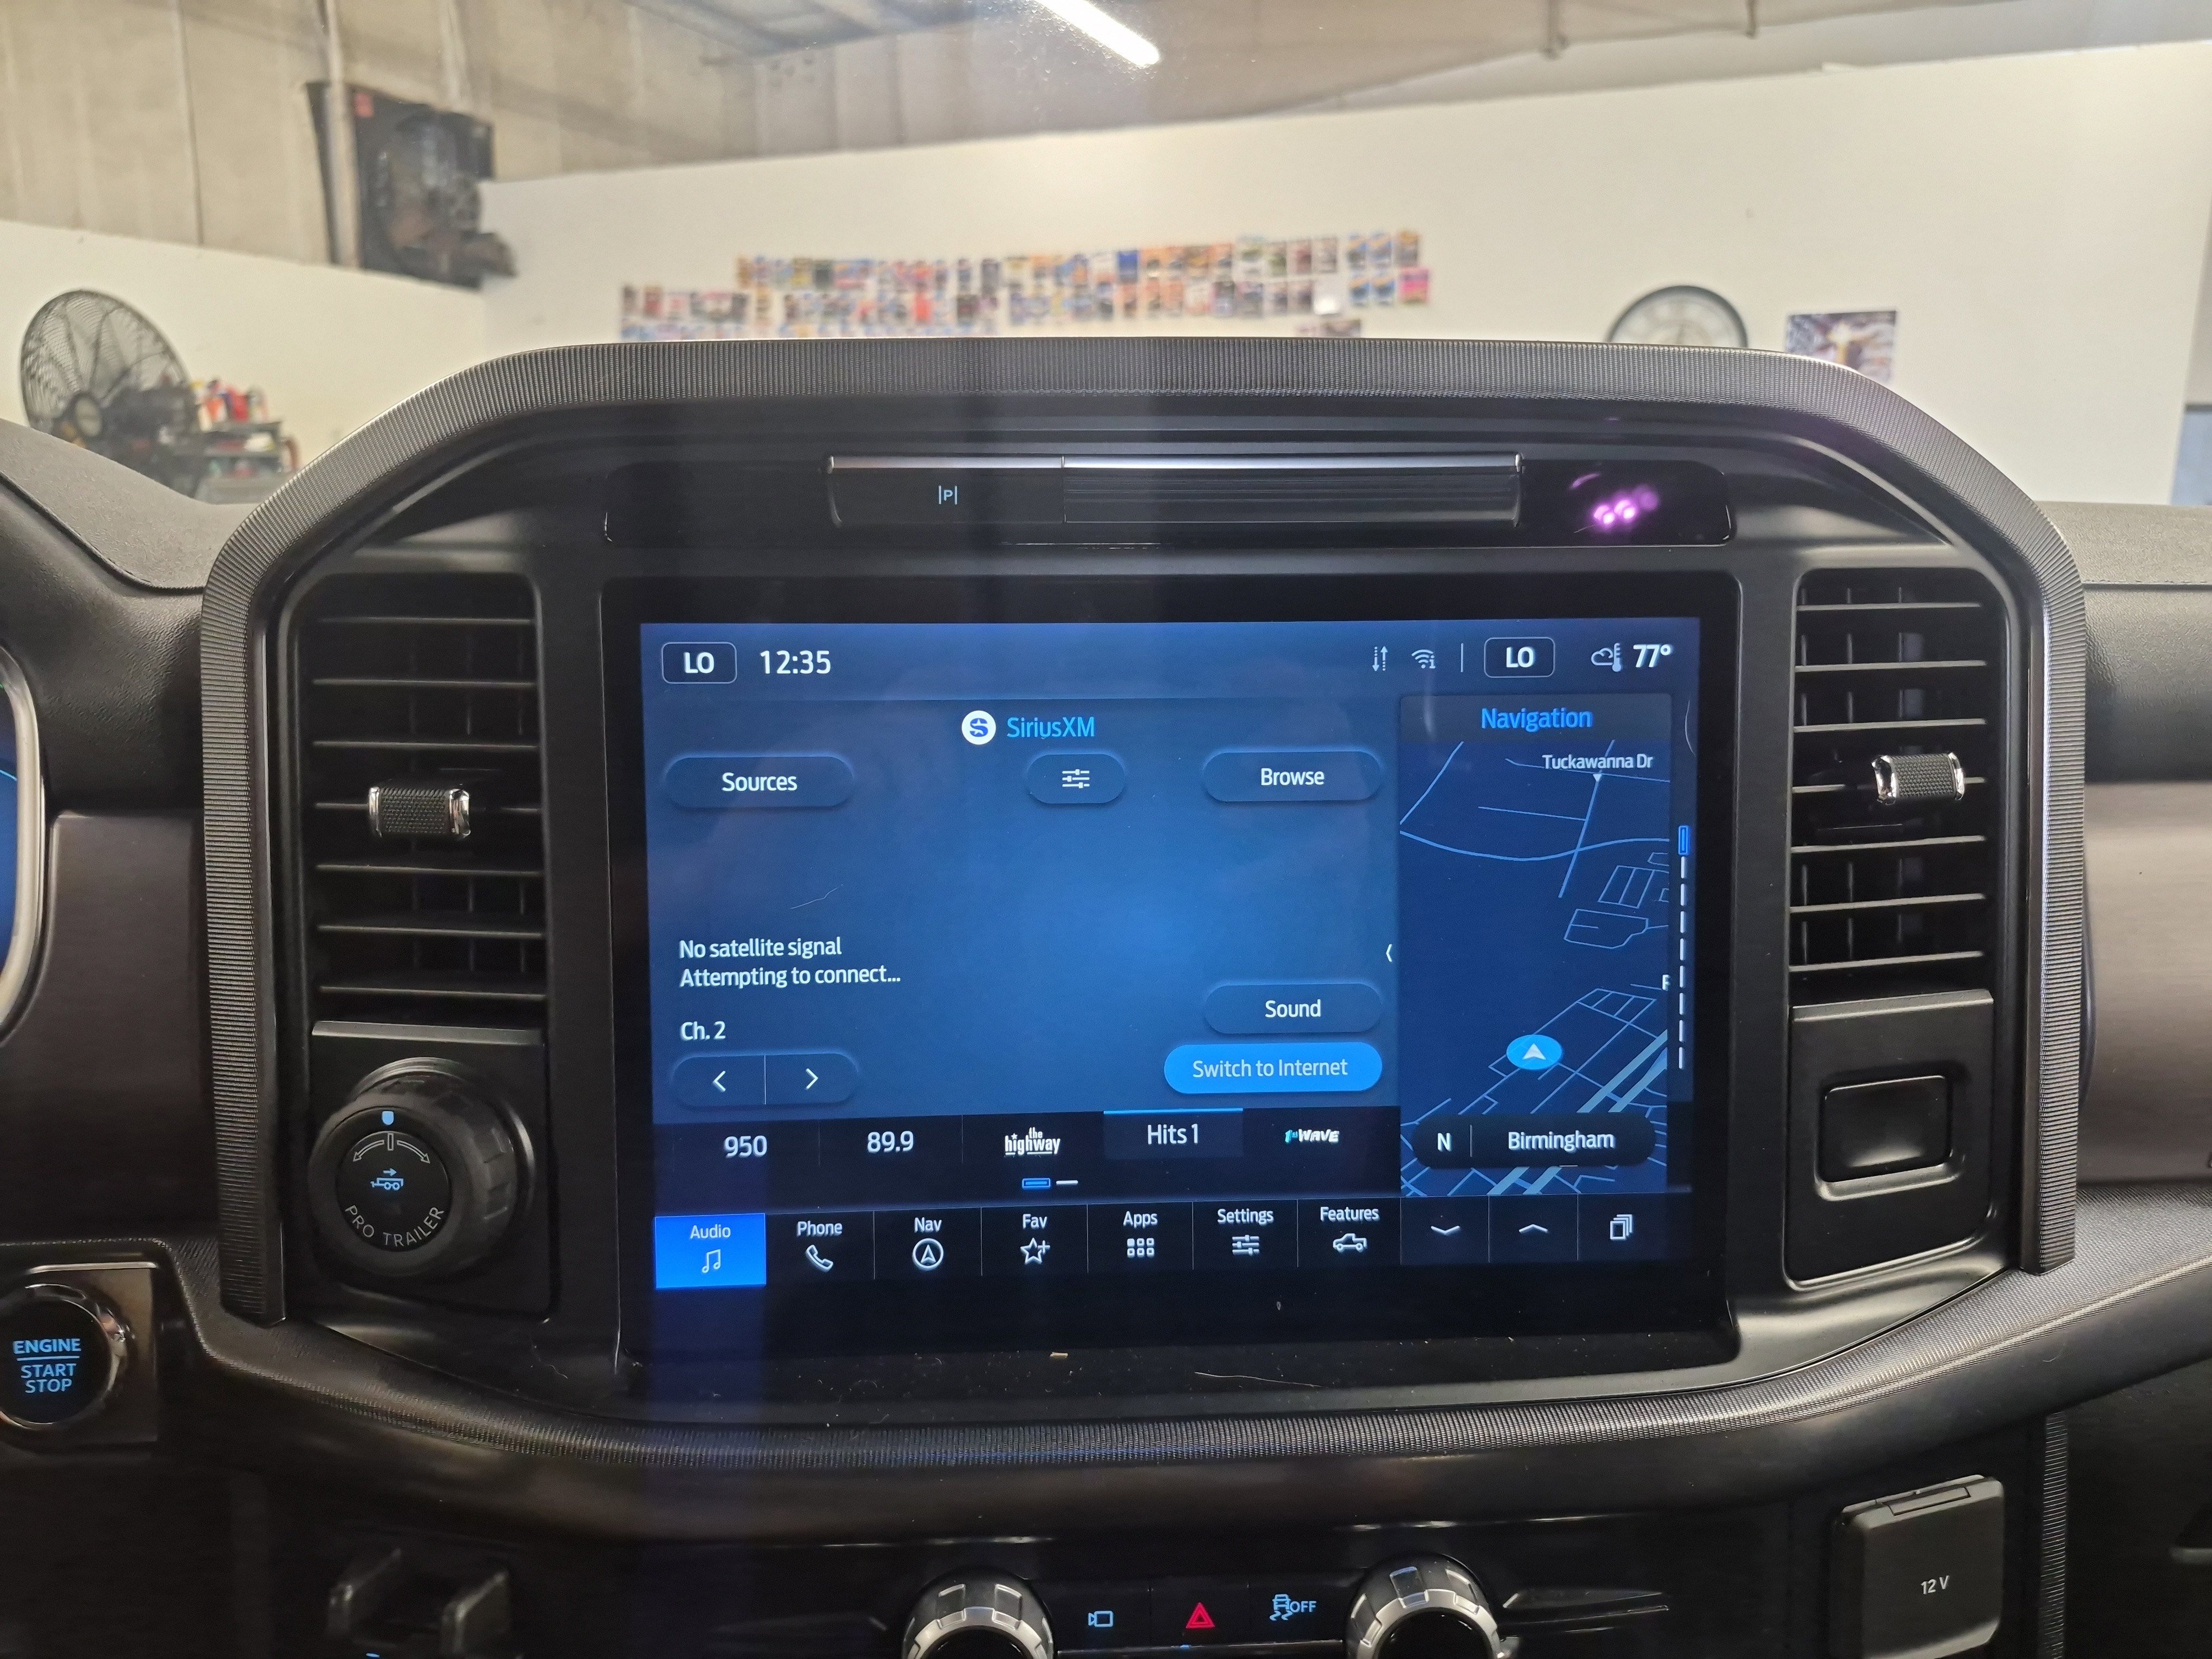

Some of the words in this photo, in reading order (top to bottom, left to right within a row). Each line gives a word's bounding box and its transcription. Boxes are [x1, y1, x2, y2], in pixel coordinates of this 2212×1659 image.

[684, 652, 715, 674] LO
[760, 650, 831, 674] 12:35
[1506, 646, 1535, 668] LO
[1006, 716, 1095, 740] SiriusXM
[1481, 707, 1593, 732] Navigation
[1542, 754, 1634, 770] Tuckawanna
[1636, 754, 1654, 768] Dr
[722, 772, 798, 792] Sources
[1261, 768, 1325, 786] Browse
[679, 940, 706, 959] No
[709, 938, 785, 958] satellite
[788, 936, 843, 959] signal
[679, 967, 788, 989] Attempting
[791, 967, 811, 985] to
[815, 964, 901, 984] connect...
[1265, 999, 1321, 1018] Sound
[680, 1021, 710, 1041] Ch.
[714, 1021, 726, 1040] 2
[1193, 1059, 1252, 1078] Switch
[1256, 1060, 1274, 1077] to
[1278, 1058, 1348, 1076] Internet
[867, 1130, 914, 1153] 89.9
[1029, 1127, 1043, 1139] the
[1147, 1124, 1187, 1145] Hits
[1191, 1123, 1199, 1144] 1
[1437, 1133, 1452, 1152] N
[1508, 1130, 1615, 1153] Birmingham
[724, 1135, 767, 1158] 950
[1005, 1133, 1061, 1156] highway
[1023, 1213, 1047, 1229] Fav
[1123, 1211, 1158, 1229] Apps
[1217, 1208, 1274, 1226] Settings
[1320, 1206, 1380, 1222] Features
[344, 1204, 375, 1238] PRO
[382, 1207, 445, 1247] TRAILER
[690, 1224, 731, 1239] Audio
[796, 1220, 843, 1236] Phone
[914, 1217, 942, 1233] Nav
[12, 1338, 81, 1354] ENGINE
[21, 1362, 77, 1378] START
[25, 1378, 72, 1394] STOP
[1921, 1579, 1937, 1594] 12
[1939, 1575, 1950, 1590] V
[1290, 1600, 1317, 1613] OFF
